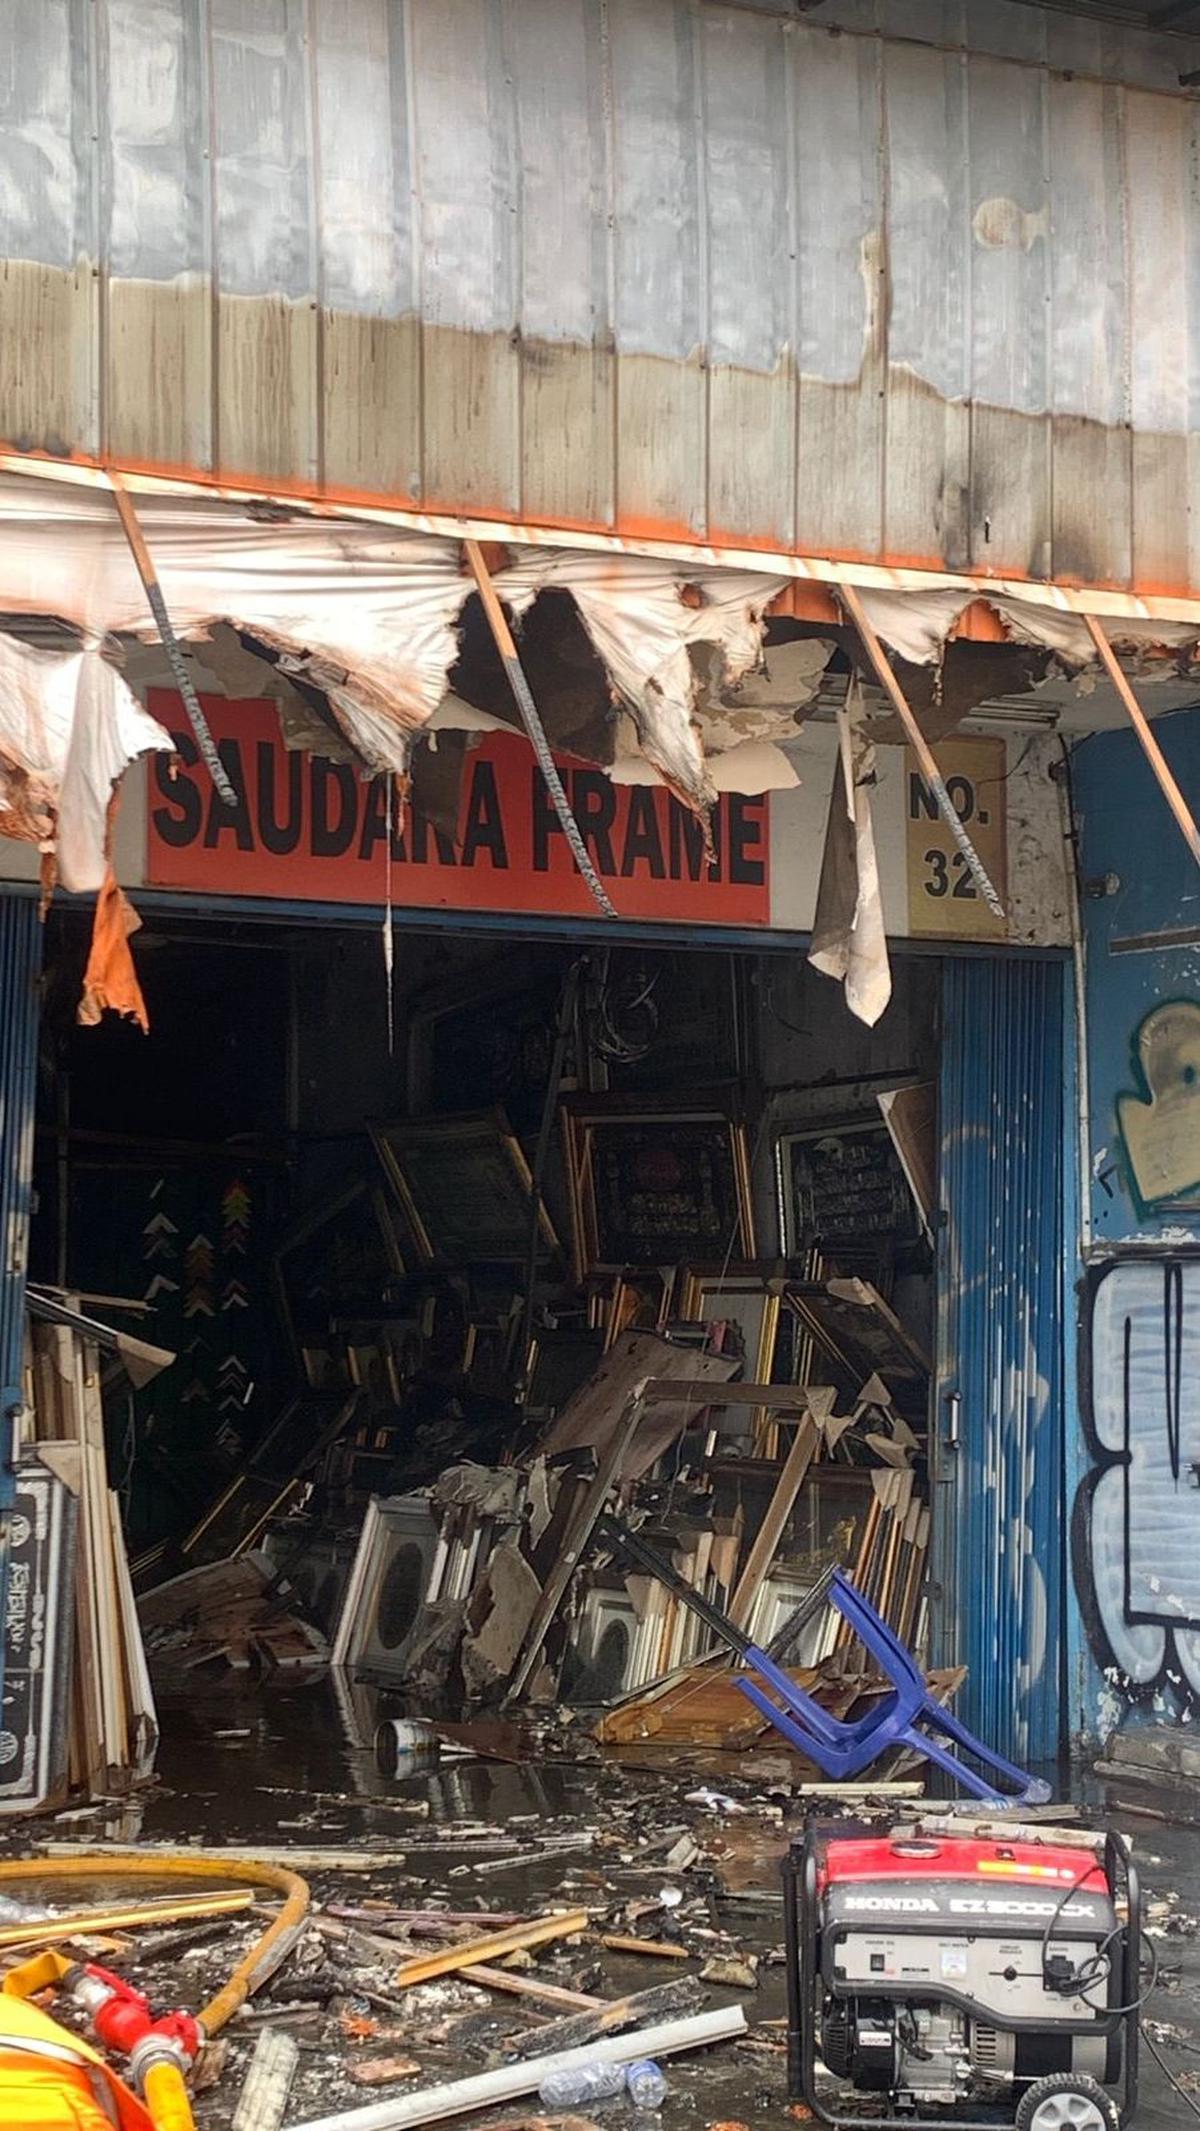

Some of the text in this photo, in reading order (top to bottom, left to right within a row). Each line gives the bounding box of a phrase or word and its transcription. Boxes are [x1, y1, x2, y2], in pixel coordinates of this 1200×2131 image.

[910, 773, 988, 825] NO.
[532, 766, 765, 885] FRAME
[924, 850, 977, 898] 32
[845, 1897, 940, 1912] HONDA
